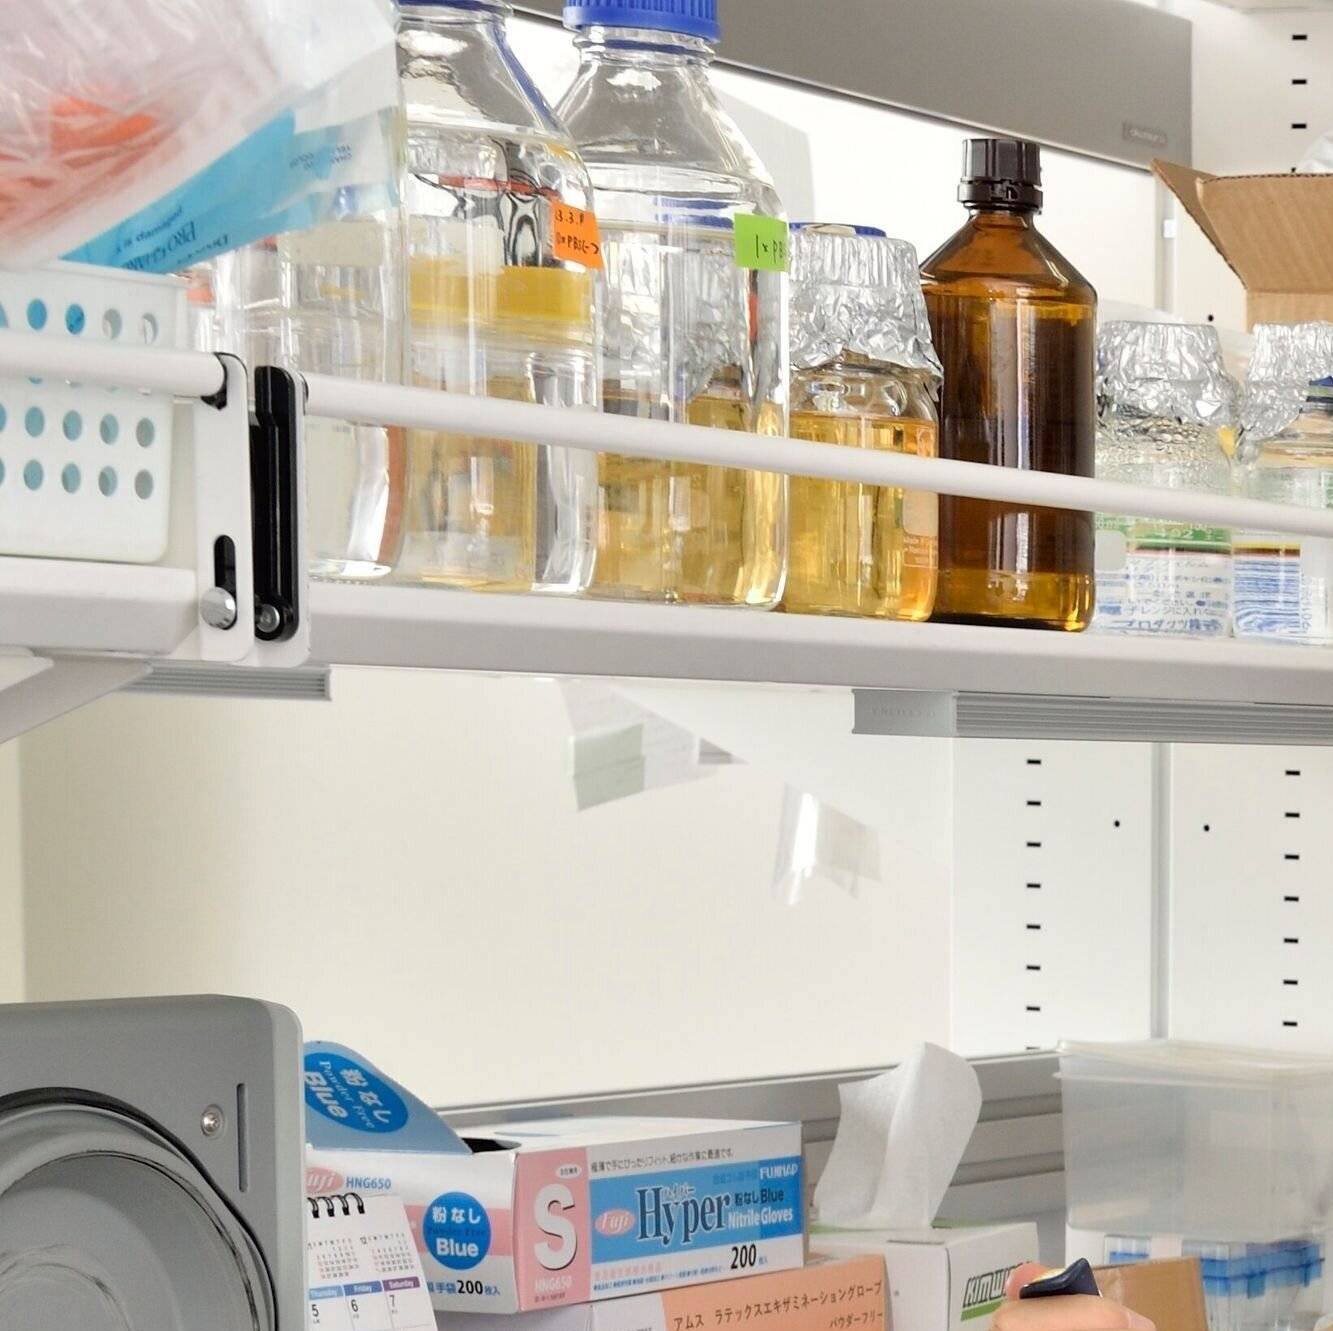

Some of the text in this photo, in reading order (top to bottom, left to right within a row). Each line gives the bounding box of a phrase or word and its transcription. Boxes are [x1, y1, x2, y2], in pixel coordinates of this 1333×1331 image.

[305, 1071, 348, 1119] Blue
[306, 1174, 392, 1191] uji HNG650
[760, 1188, 784, 1204] Blue
[432, 1207, 481, 1224] 粉なし
[599, 1212, 630, 1229] Fuji
[636, 1185, 731, 1246] Hyper
[728, 1206, 793, 1229] Nitrile Gloves
[534, 1184, 578, 1271] S
[436, 1238, 480, 1257] Blue
[311, 1295, 396, 1318] 5 6 7
[673, 1279, 883, 1331] アムス ラテックスエキザミネーショングローブ
[829, 1311, 884, 1330] パウダーフリー
